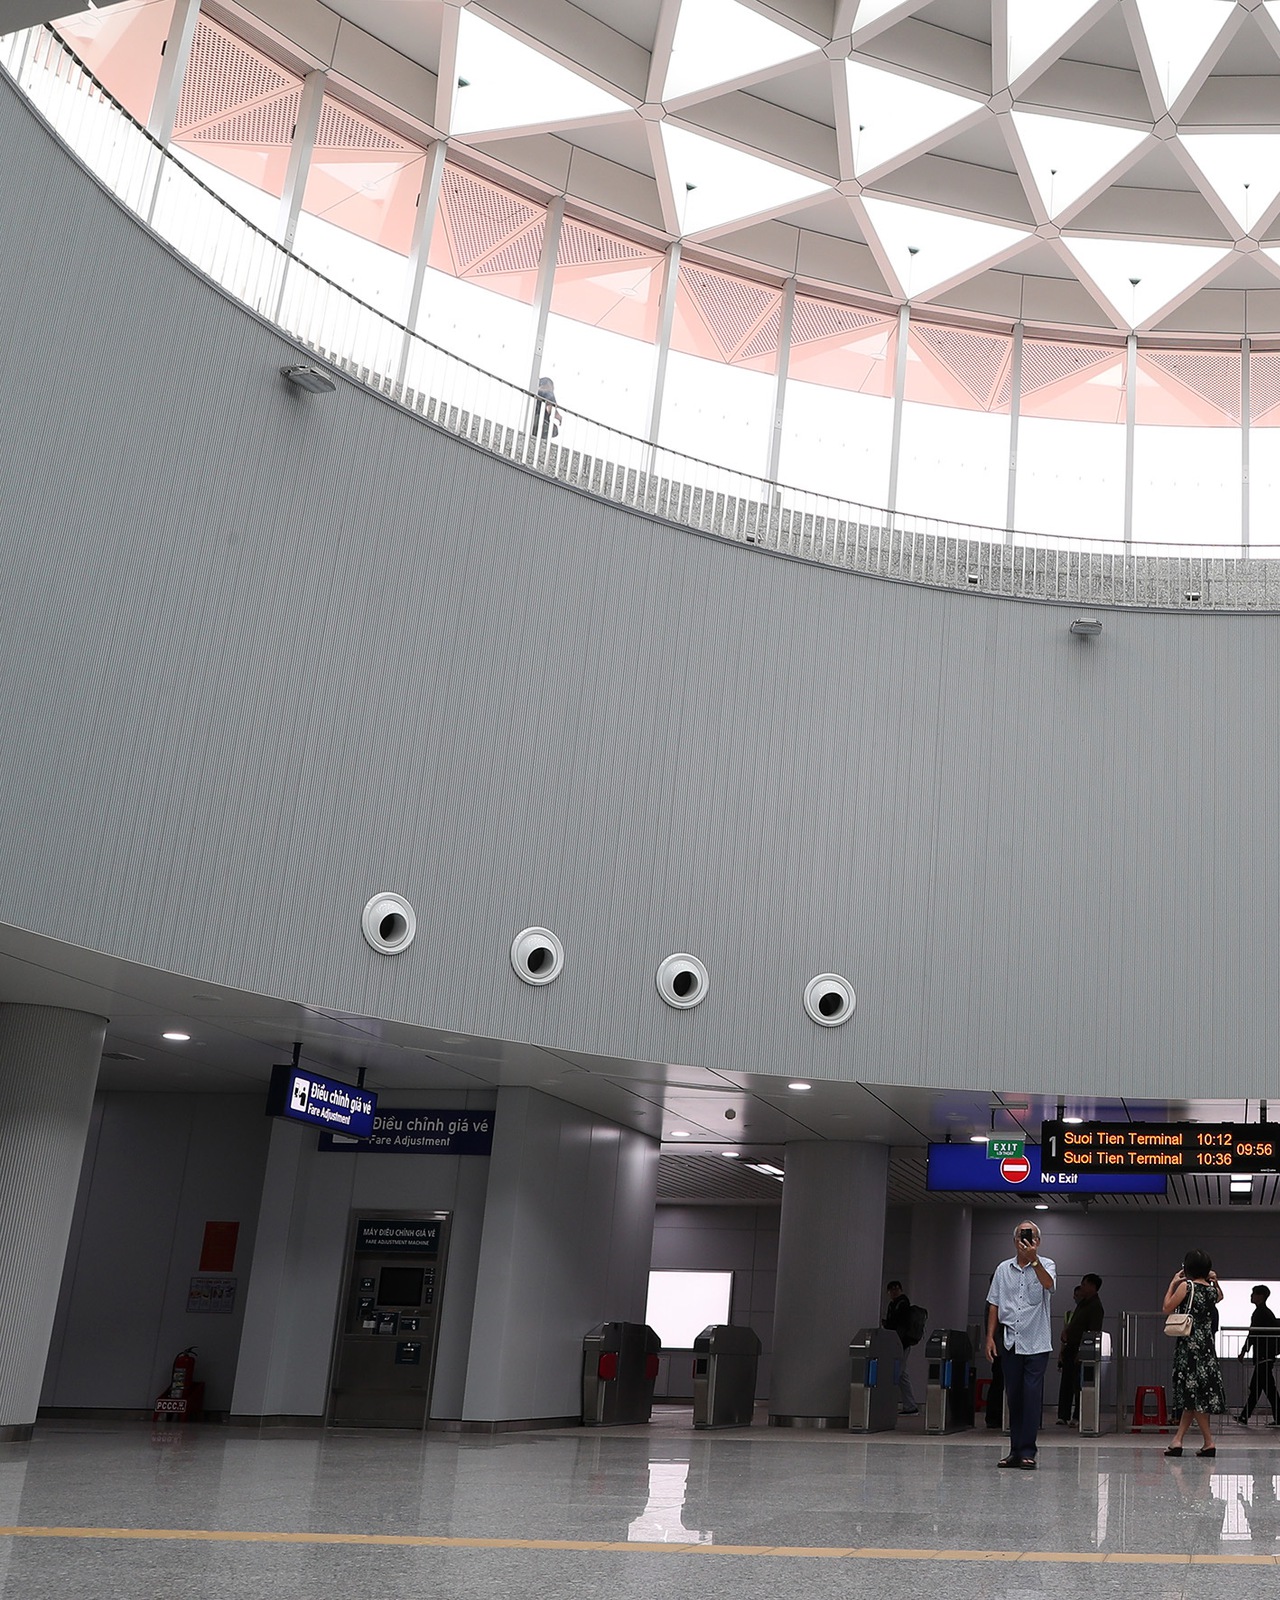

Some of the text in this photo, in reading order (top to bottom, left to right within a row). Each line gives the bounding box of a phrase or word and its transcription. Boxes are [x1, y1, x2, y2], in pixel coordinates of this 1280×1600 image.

[310, 1082, 372, 1115] Điều chỉnh giá vé
[307, 1102, 351, 1126] Fare Adjustment
[372, 1115, 489, 1135] Điều chỉnh giá vé
[368, 1134, 450, 1148] Fare Adjustment
[1063, 1131, 1232, 1146] Suoi Tien Terminal 10:12
[993, 1143, 1018, 1151] EXIT
[1048, 1135, 1057, 1158] 1
[1236, 1143, 1273, 1157] 09:56
[1063, 1151, 1232, 1166] Suoi Tien Terminal 10:36
[1040, 1172, 1078, 1184] No Exit
[362, 1227, 379, 1236] MÁY
[156, 1401, 178, 1411] PCCC
